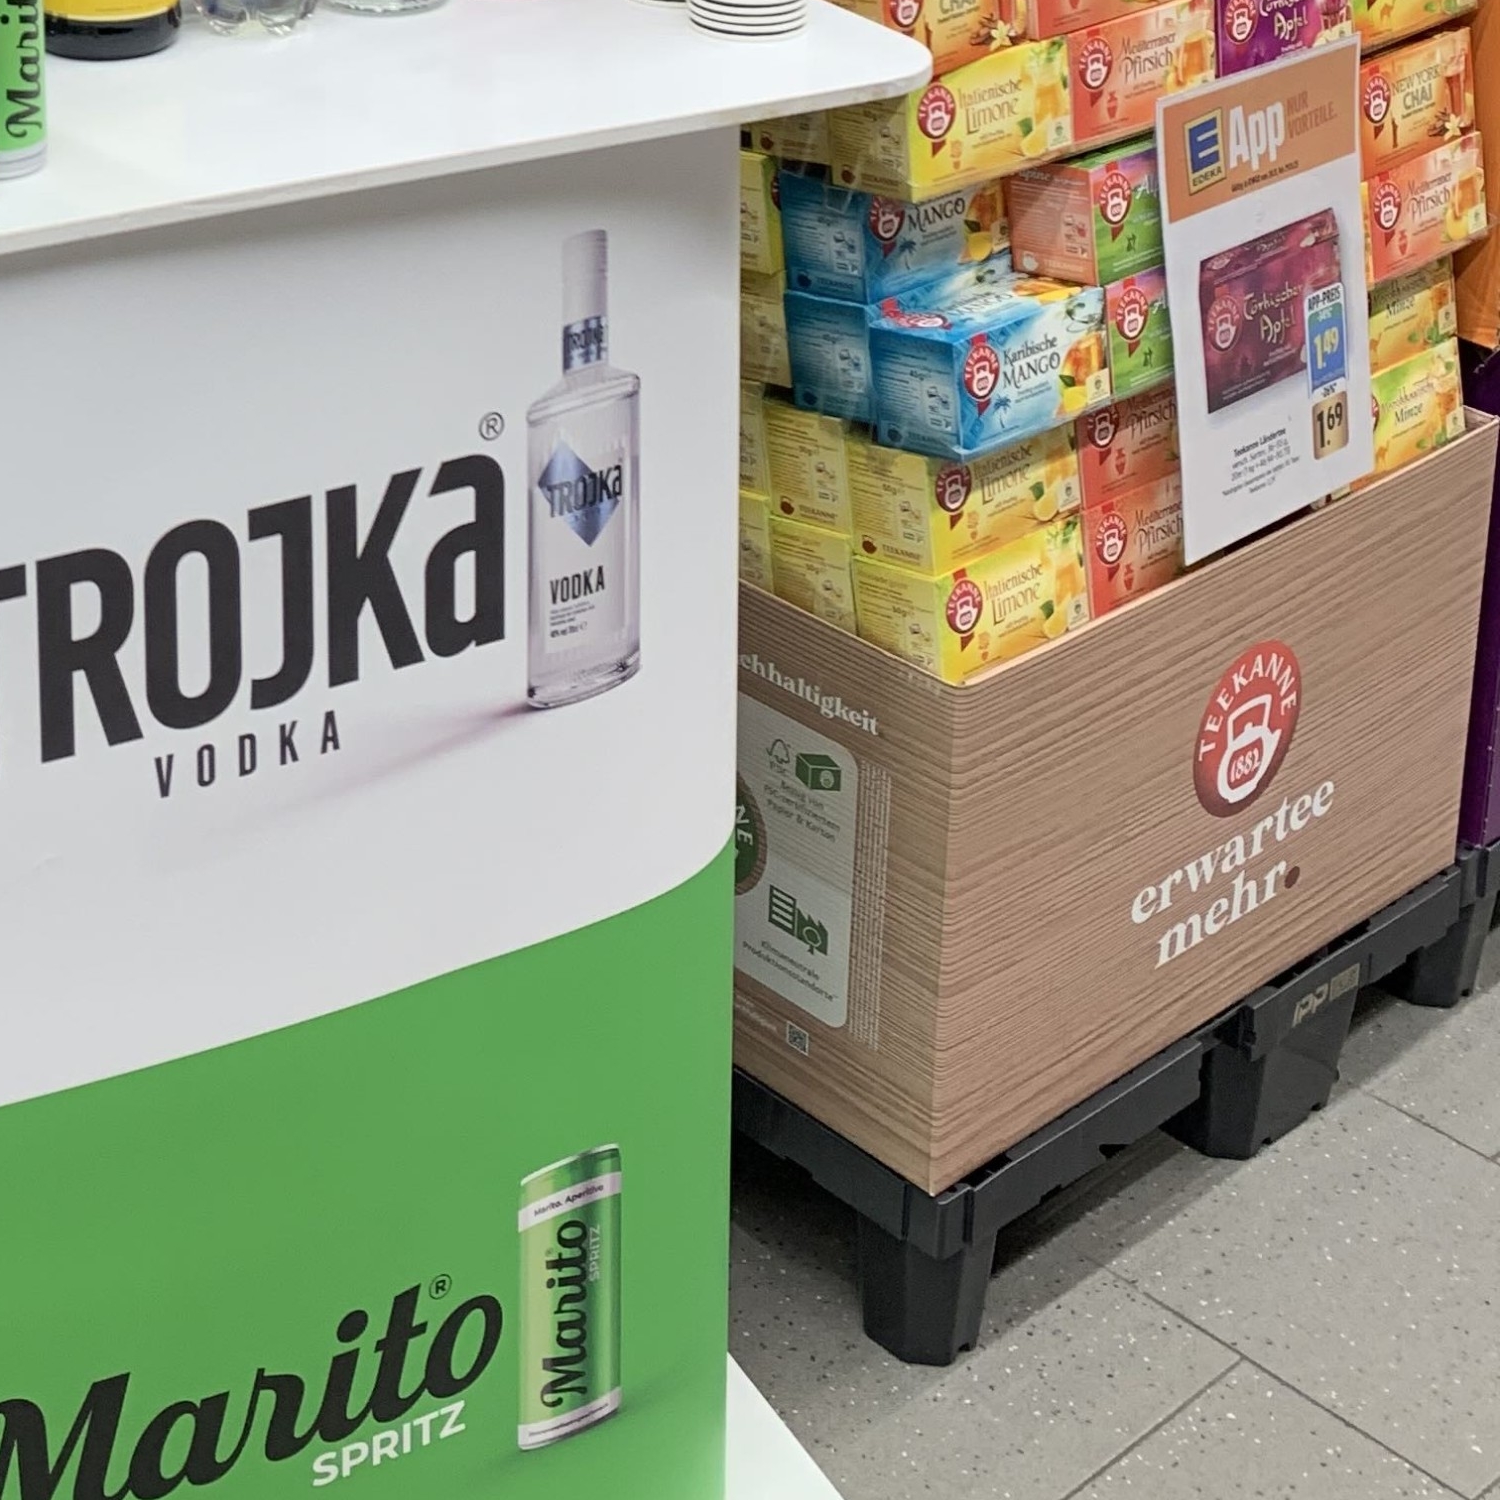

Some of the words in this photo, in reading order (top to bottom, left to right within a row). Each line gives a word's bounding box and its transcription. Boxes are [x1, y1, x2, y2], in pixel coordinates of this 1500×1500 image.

[1119, 48, 1175, 84] Pfirsich
[1391, 78, 1410, 96] NEW
[1410, 65, 1441, 90] YORK
[957, 77, 1023, 108] Italienische
[1287, 90, 1309, 117] NUR
[1402, 83, 1434, 111] CHAI
[965, 97, 1019, 135] Limone
[1229, 100, 1286, 172] App
[1287, 101, 1338, 139] VORTEILE.
[1192, 166, 1223, 187] EDEKA
[907, 196, 966, 233] MANGO
[1407, 185, 1451, 222] Pfirsich
[1307, 284, 1342, 311] APP-PREIS
[1386, 295, 1415, 319] Minze
[1003, 334, 1058, 366] Karibische
[1002, 353, 1061, 390] MANGO
[1125, 402, 1178, 440] Pfirsich
[1394, 401, 1424, 426] Minze
[980, 462, 1030, 505] Limone
[549, 565, 606, 605] VODKA
[983, 563, 1043, 602] Italienische
[991, 581, 1041, 626] Limone
[738, 652, 880, 736] chhaltigkeit
[1198, 652, 1298, 762] TEEKANNE
[153, 711, 341, 799] VODKA
[1229, 748, 1263, 784] 1882
[1130, 780, 1336, 925] erwartee
[564, 1183, 604, 1205] Aperitivo
[589, 1224, 601, 1282] SPRITZ
[540, 1219, 589, 1409] Marito
[311, 1401, 468, 1487] SPRITZ
